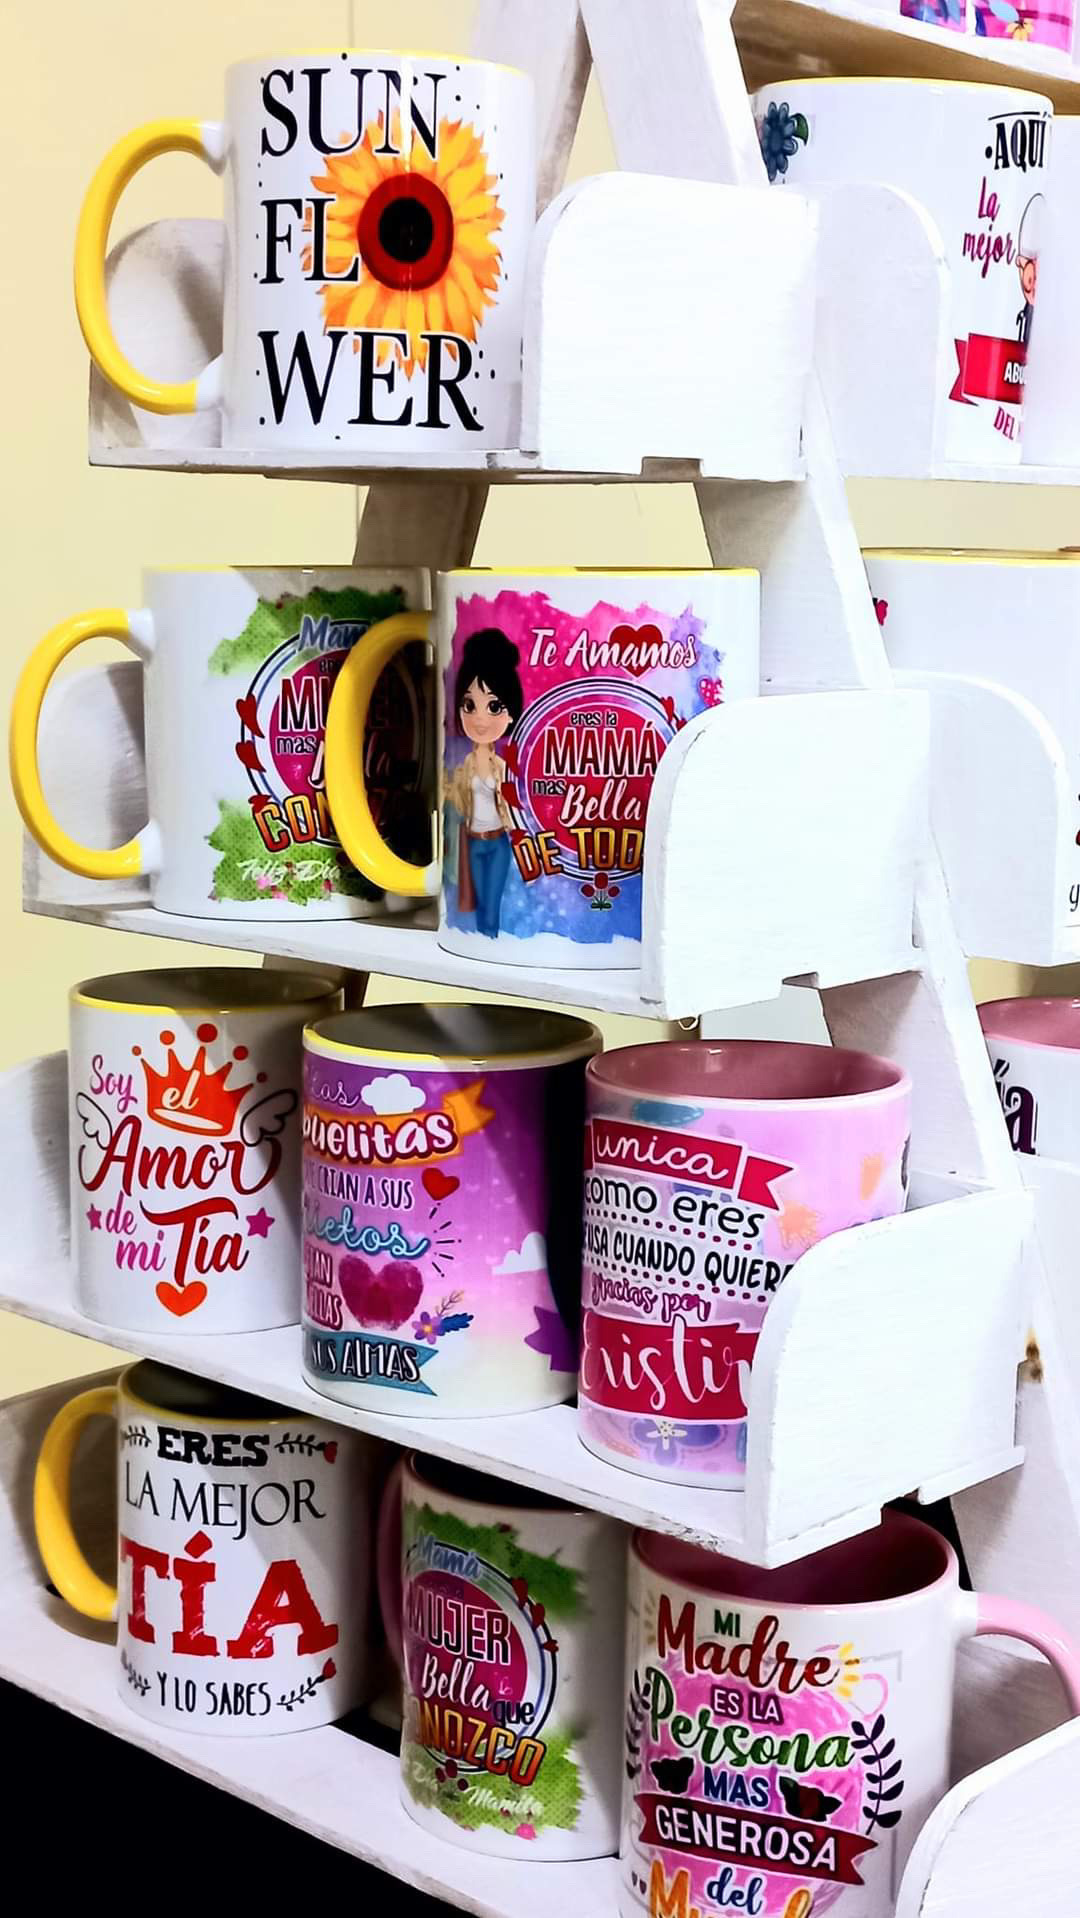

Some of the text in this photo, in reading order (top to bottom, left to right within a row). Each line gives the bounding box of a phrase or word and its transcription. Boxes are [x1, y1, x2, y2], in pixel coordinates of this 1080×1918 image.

[261, 68, 447, 159] SUN
[977, 176, 1001, 222] La
[962, 222, 1017, 279] mejor
[257, 330, 484, 432] WER
[993, 406, 1015, 441] DEL
[529, 628, 698, 672] Te Amamos
[570, 711, 618, 727] eres la
[276, 735, 318, 755] mas
[543, 719, 658, 778] MAMÁ
[532, 778, 642, 822] mas Bella
[511, 826, 645, 883] DE TOD
[89, 1053, 200, 1114] Soy el
[79, 1114, 283, 1197] Amor
[595, 1134, 730, 1181] unica
[105, 1190, 137, 1235] de
[364, 1176, 376, 1206] A
[380, 1178, 415, 1211] SUS
[672, 1195, 766, 1239] eres
[115, 1229, 167, 1272] mi
[612, 1230, 696, 1277] CUANDO
[660, 1292, 712, 1324] por
[157, 1425, 270, 1467] ERES
[126, 1460, 327, 1541] LA MEJOR
[120, 1530, 339, 1659] TÍA
[657, 1593, 840, 1694] Madre
[713, 1609, 741, 1638] MI
[156, 1671, 271, 1717] Y LO SABES
[421, 1652, 536, 1728] Bella que
[713, 1688, 781, 1722] ES LA
[645, 1665, 856, 1774] Persona
[703, 1765, 770, 1807] MAS
[654, 1803, 837, 1872] GENEROSA
[706, 1867, 764, 1916] del
